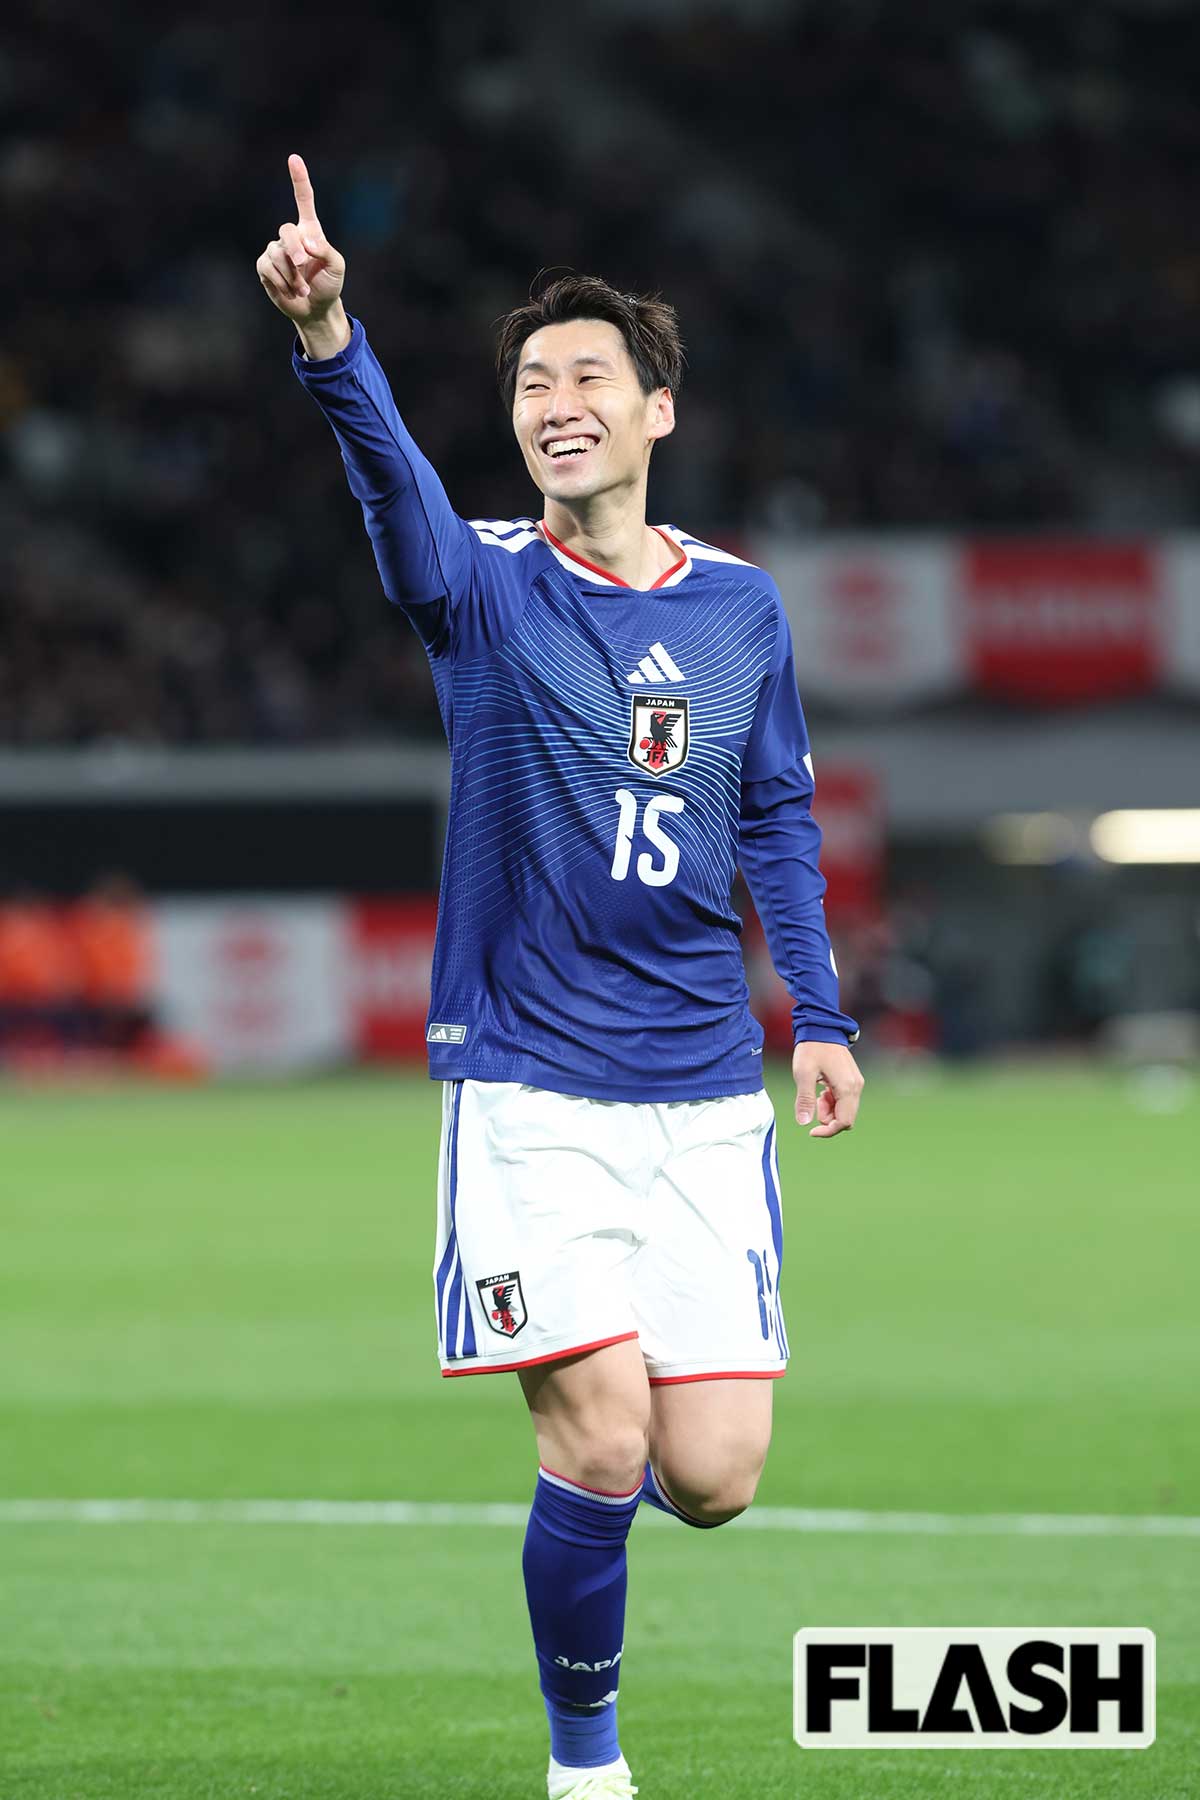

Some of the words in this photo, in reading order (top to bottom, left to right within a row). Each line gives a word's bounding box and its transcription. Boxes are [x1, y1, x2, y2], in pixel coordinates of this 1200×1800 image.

[645, 698, 675, 708] JAPAN
[642, 750, 670, 764] JFA
[610, 788, 685, 887] 15
[484, 1274, 510, 1286] JAPAN
